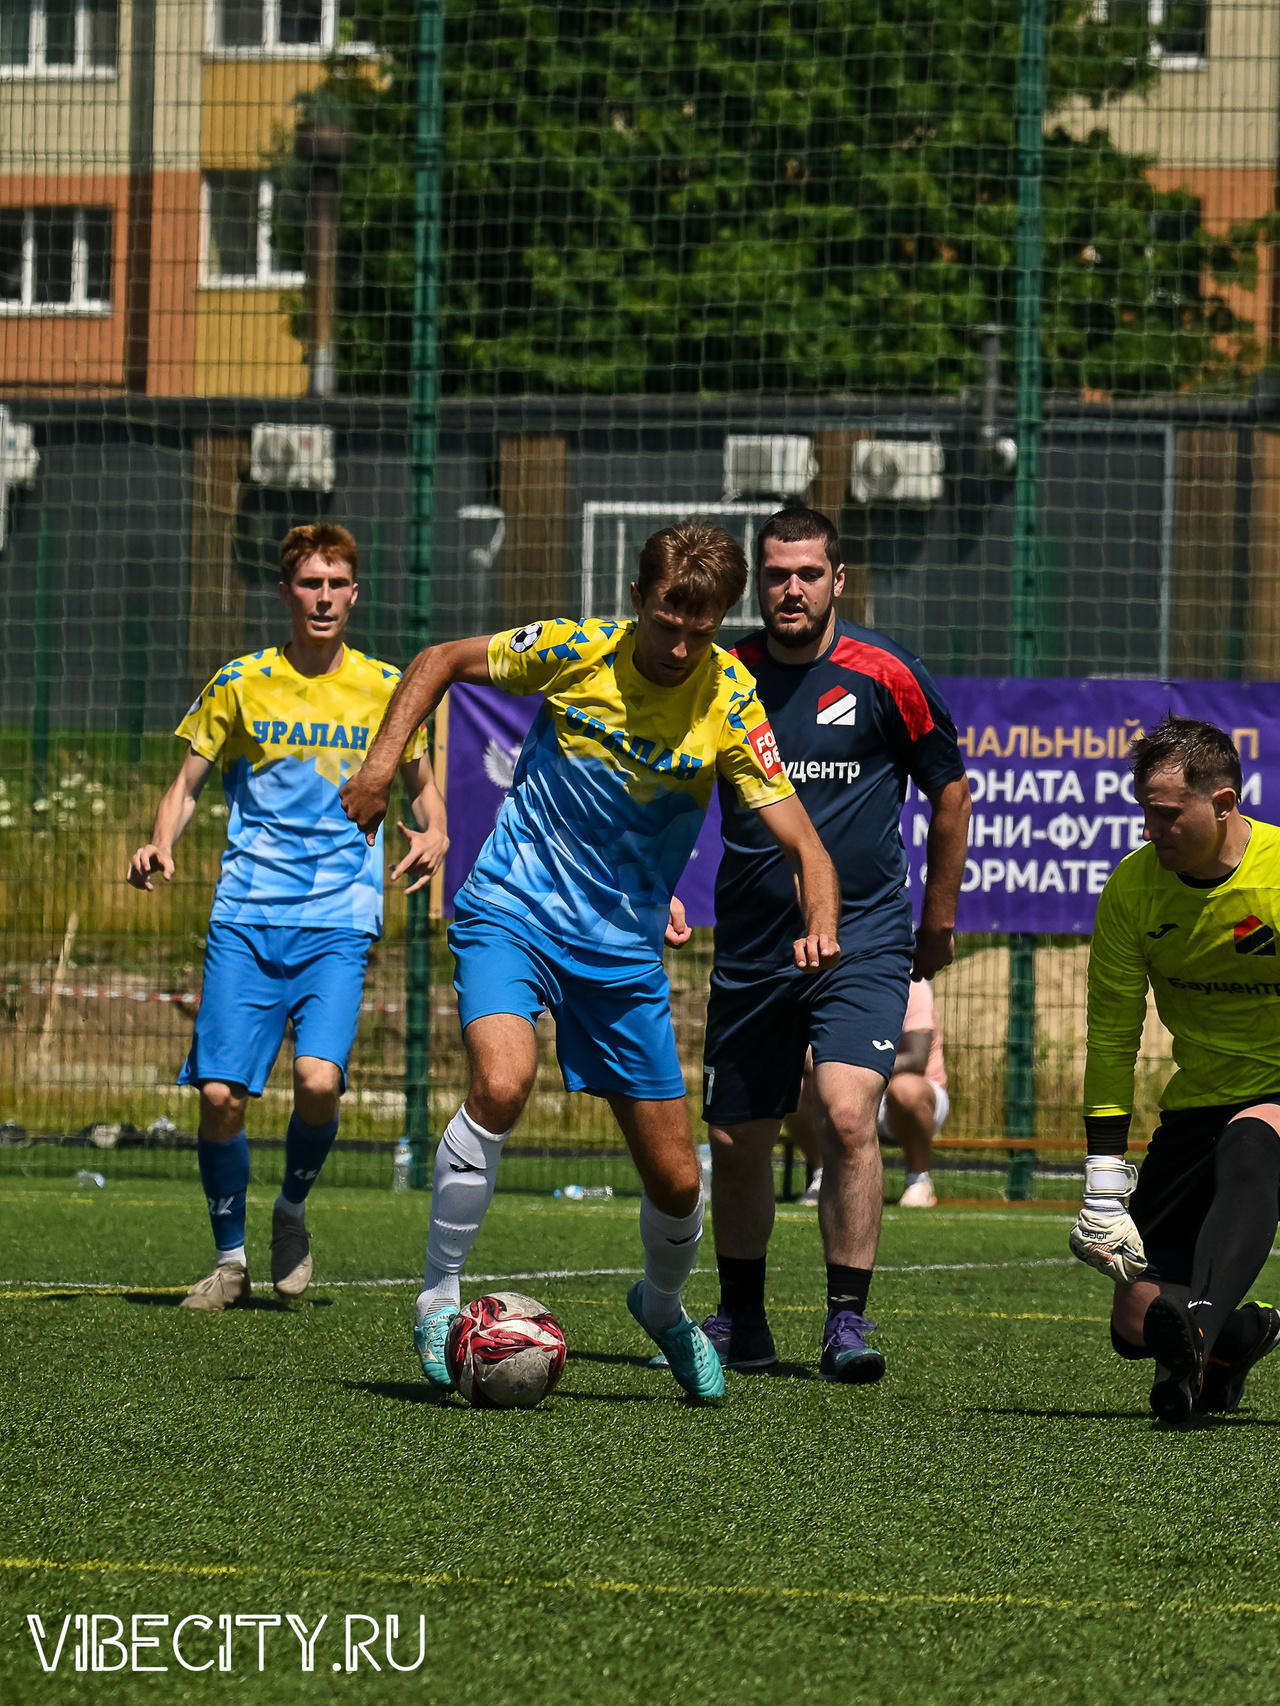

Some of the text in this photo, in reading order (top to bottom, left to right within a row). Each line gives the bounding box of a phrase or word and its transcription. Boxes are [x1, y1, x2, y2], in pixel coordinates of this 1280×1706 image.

[252, 720, 370, 751] УРАЛАН
[566, 705, 704, 781] УРАЛАН
[920, 857, 1111, 894] ОРМАТЕ
